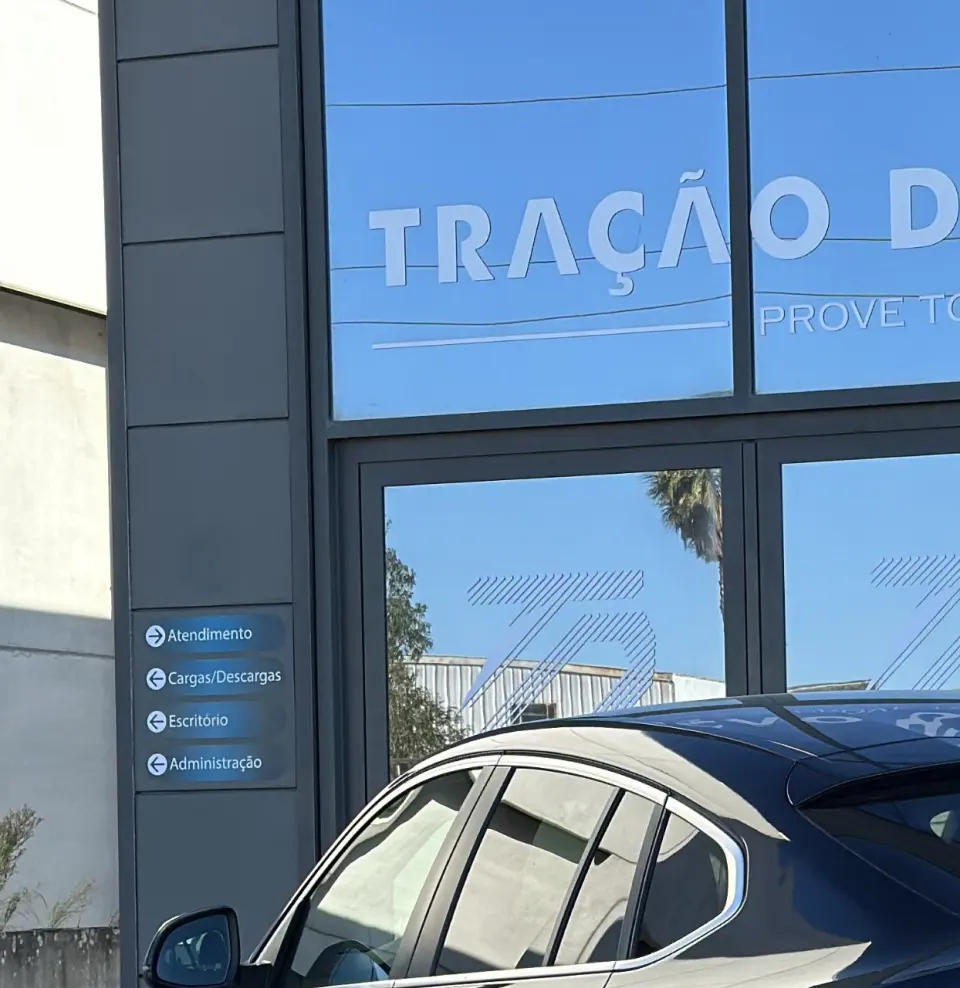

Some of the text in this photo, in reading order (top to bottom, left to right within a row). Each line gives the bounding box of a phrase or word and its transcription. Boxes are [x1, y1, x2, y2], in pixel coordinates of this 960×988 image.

[368, 168, 831, 297] TRAÇÃO
[759, 297, 906, 337] PROVE
[167, 627, 253, 642] Atendimento
[168, 669, 282, 688] Cargas/Descargas
[168, 712, 229, 728] Escritório
[169, 755, 263, 773] Administração
